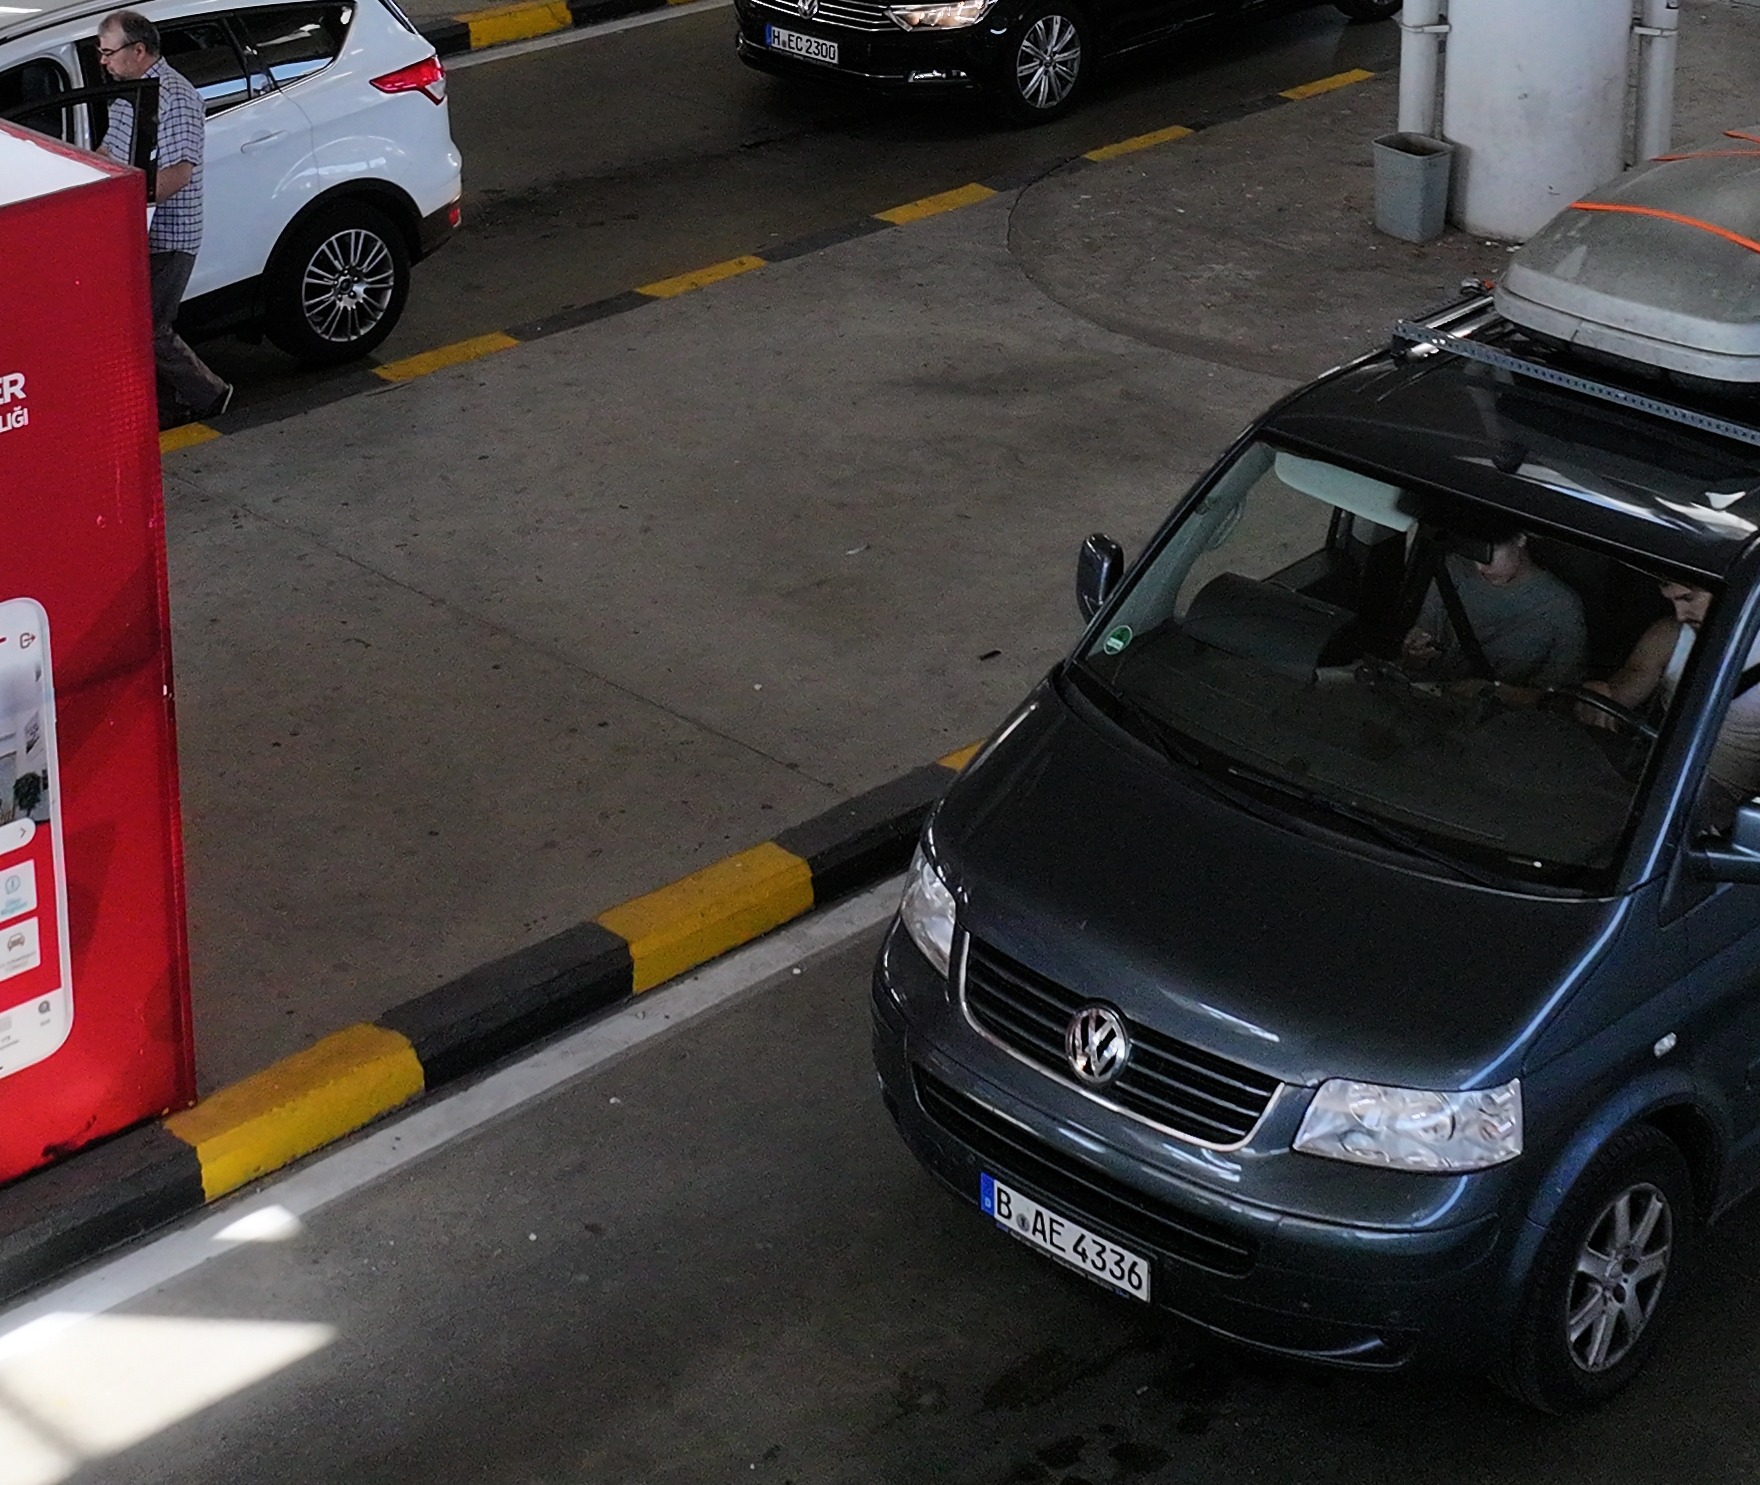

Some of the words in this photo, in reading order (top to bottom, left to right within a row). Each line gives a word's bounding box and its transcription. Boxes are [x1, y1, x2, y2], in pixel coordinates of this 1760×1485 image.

[772, 29, 781, 46] H
[787, 35, 804, 52] EC
[805, 39, 837, 61] 2300
[996, 1186, 1014, 1220] B
[1031, 1209, 1068, 1254] AE
[1072, 1232, 1146, 1292] 4336
